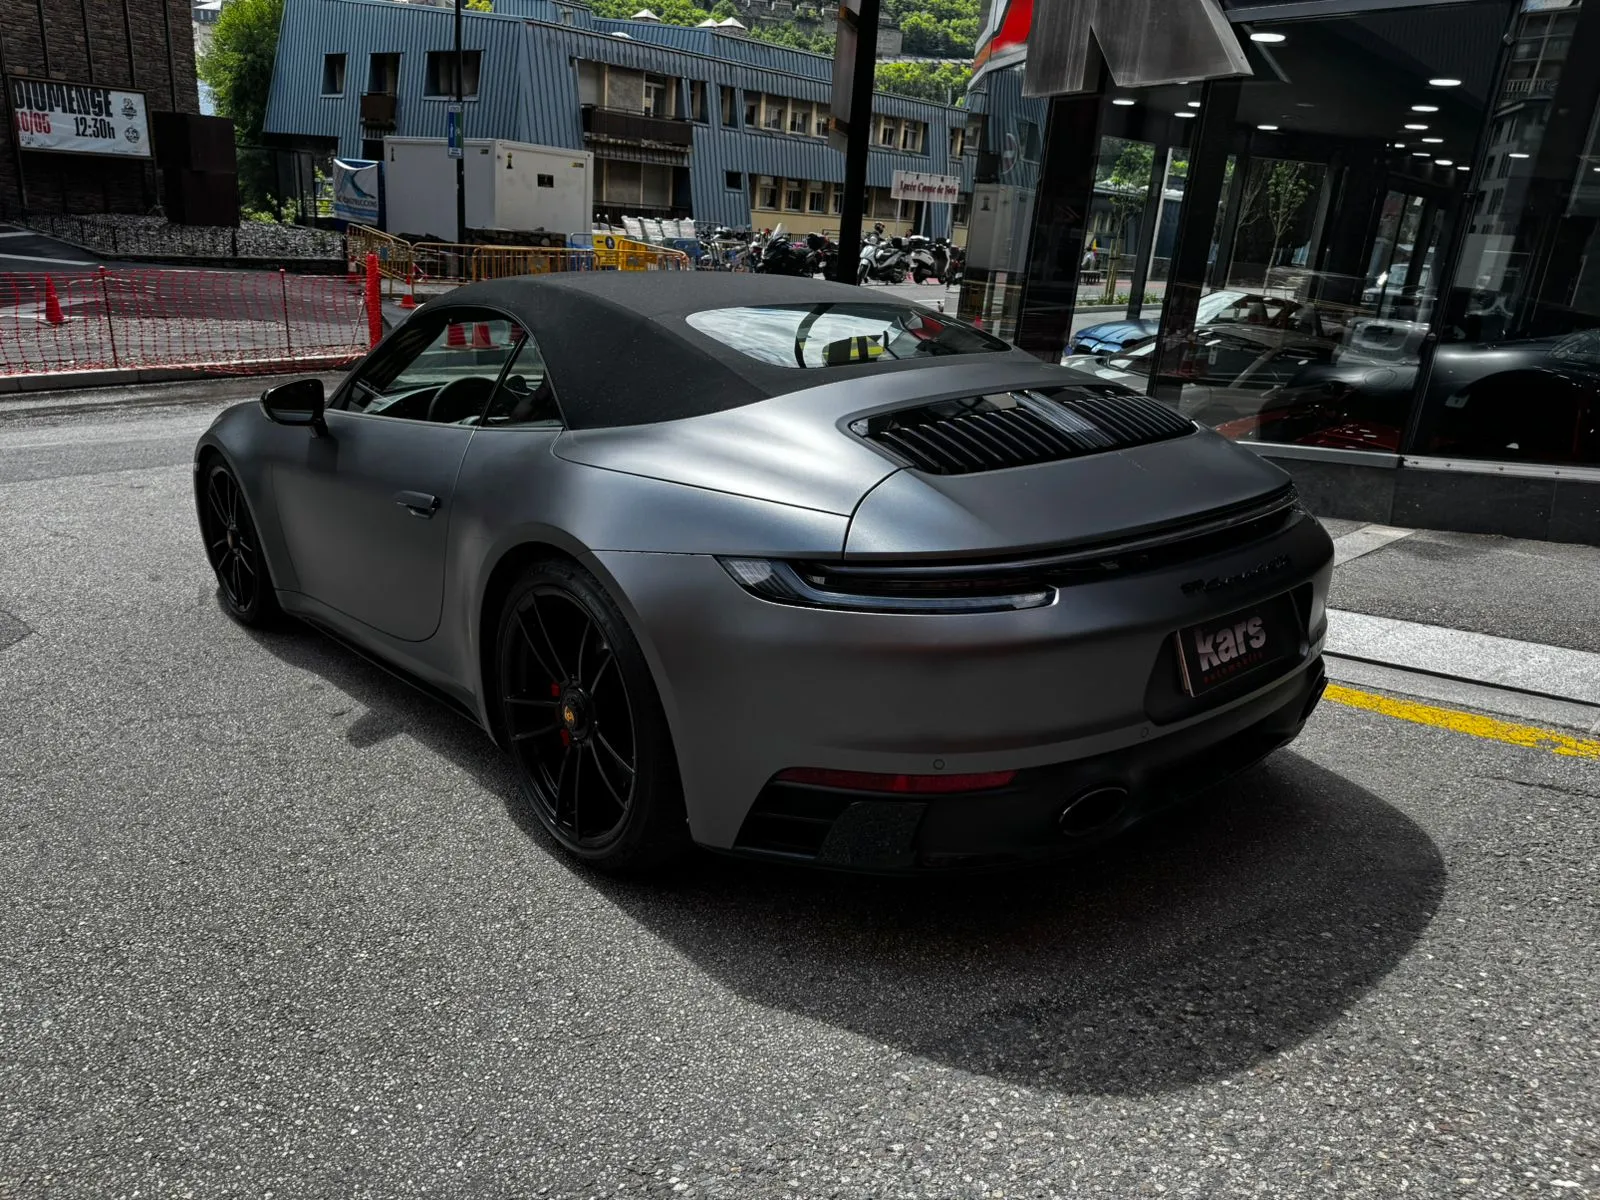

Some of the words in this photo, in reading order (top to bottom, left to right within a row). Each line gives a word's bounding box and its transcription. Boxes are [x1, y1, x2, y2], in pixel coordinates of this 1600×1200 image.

[14, 80, 113, 117] DIUMENGE
[74, 116, 115, 139] 12:30h
[1194, 616, 1266, 672] kars
